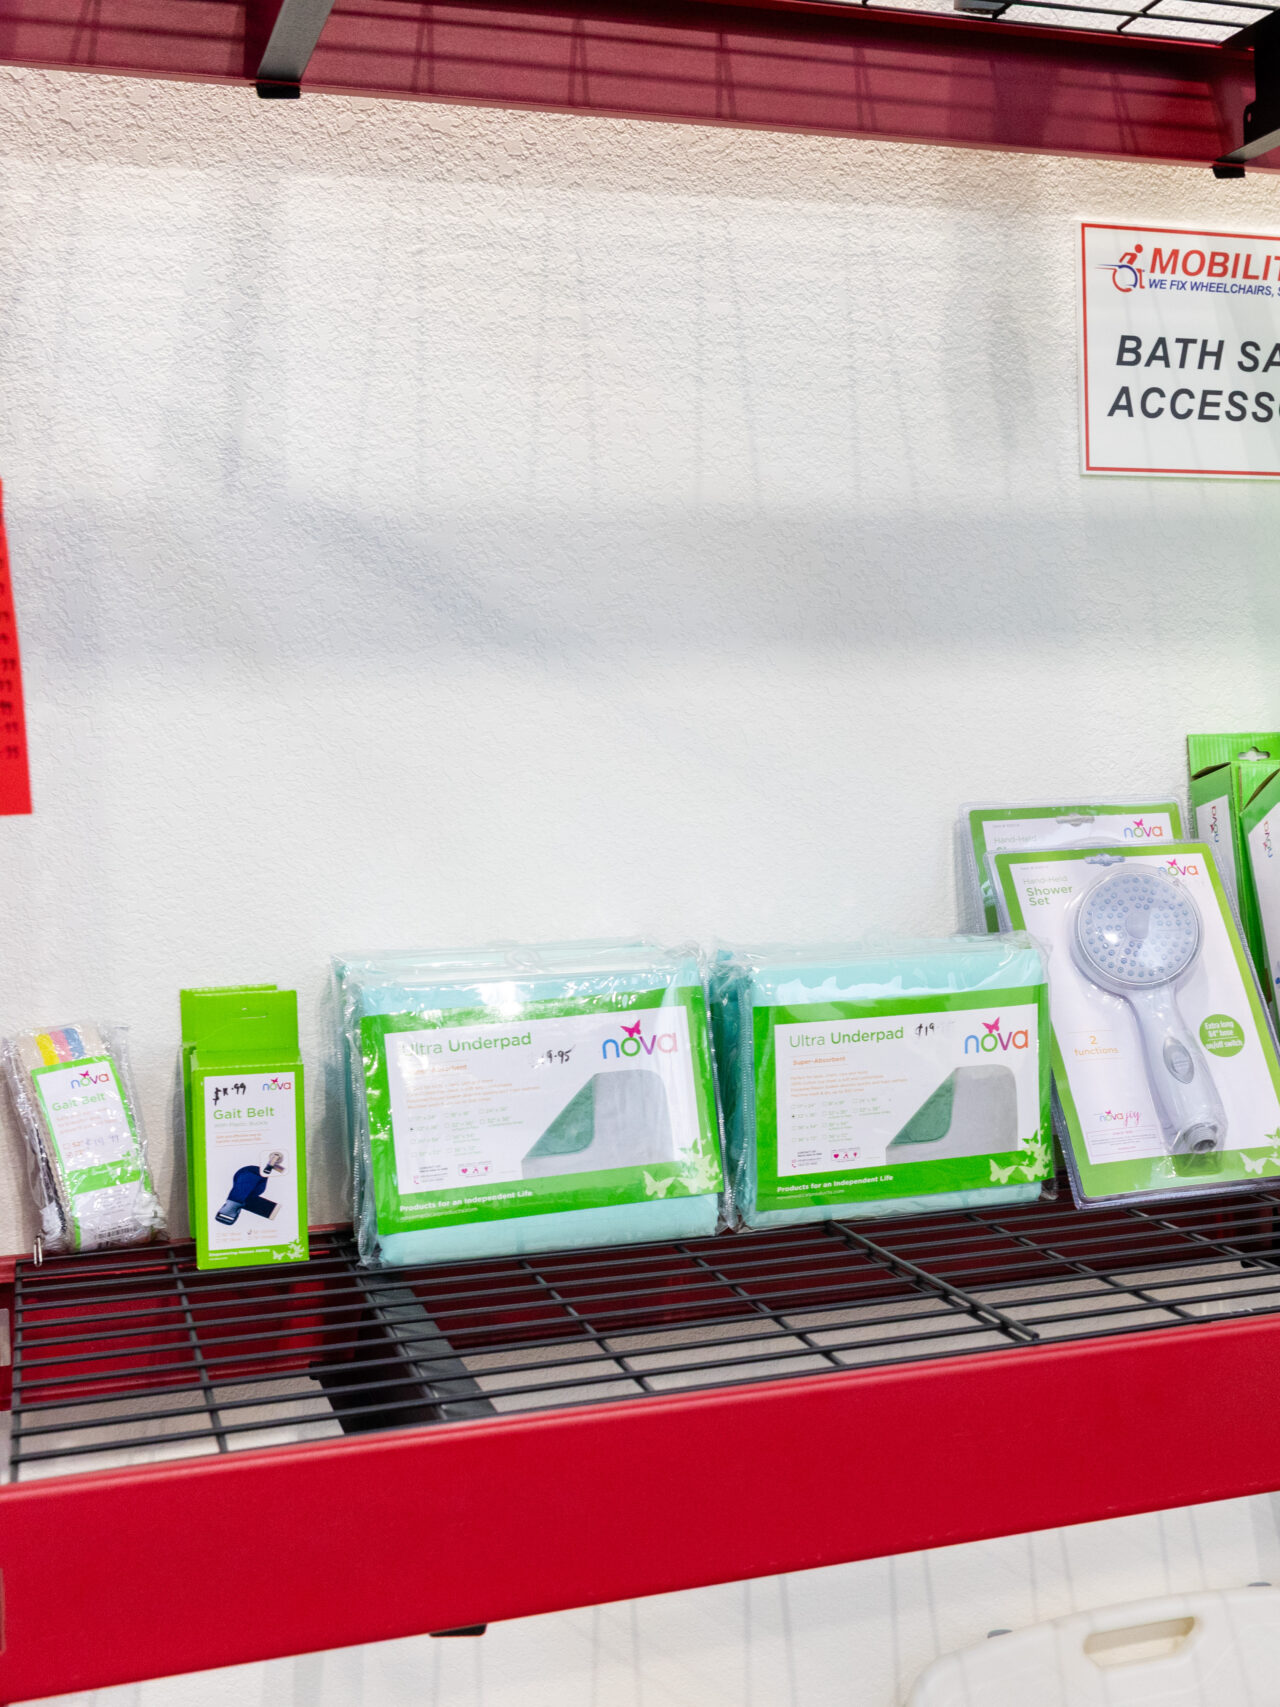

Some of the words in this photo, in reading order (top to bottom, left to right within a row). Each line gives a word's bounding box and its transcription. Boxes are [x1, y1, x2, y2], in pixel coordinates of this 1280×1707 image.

[1148, 278, 1167, 290] WE
[1169, 280, 1188, 291] FIX
[1190, 281, 1274, 298] WHEELCHAIRS,
[1116, 335, 1225, 371] BATH
[1123, 825, 1163, 839] nova
[1210, 805, 1220, 843] nova
[1263, 820, 1273, 858] nova
[1026, 885, 1073, 897] Shower
[1028, 896, 1050, 907] Set
[448, 1031, 532, 1052] Underpad
[601, 1032, 679, 1060] nova
[789, 1032, 826, 1048] Ultra
[830, 1026, 904, 1045] Underpad
[964, 1029, 1029, 1055] nova
[1089, 1035, 1098, 1045] 2
[1074, 1046, 1120, 1057] functions
[70, 1073, 110, 1089] nova
[262, 1081, 292, 1092] nova
[213, 1107, 243, 1120] Gait
[247, 1106, 275, 1118] Belt
[1099, 1112, 1124, 1122] nova
[776, 1184, 810, 1193] Products
[834, 1175, 879, 1187] Independent
[880, 1174, 894, 1182] Life
[399, 1201, 436, 1212] Products
[438, 1200, 450, 1208] for
[452, 1198, 463, 1206] an
[464, 1191, 516, 1205] Independent
[517, 1189, 533, 1198] Life
